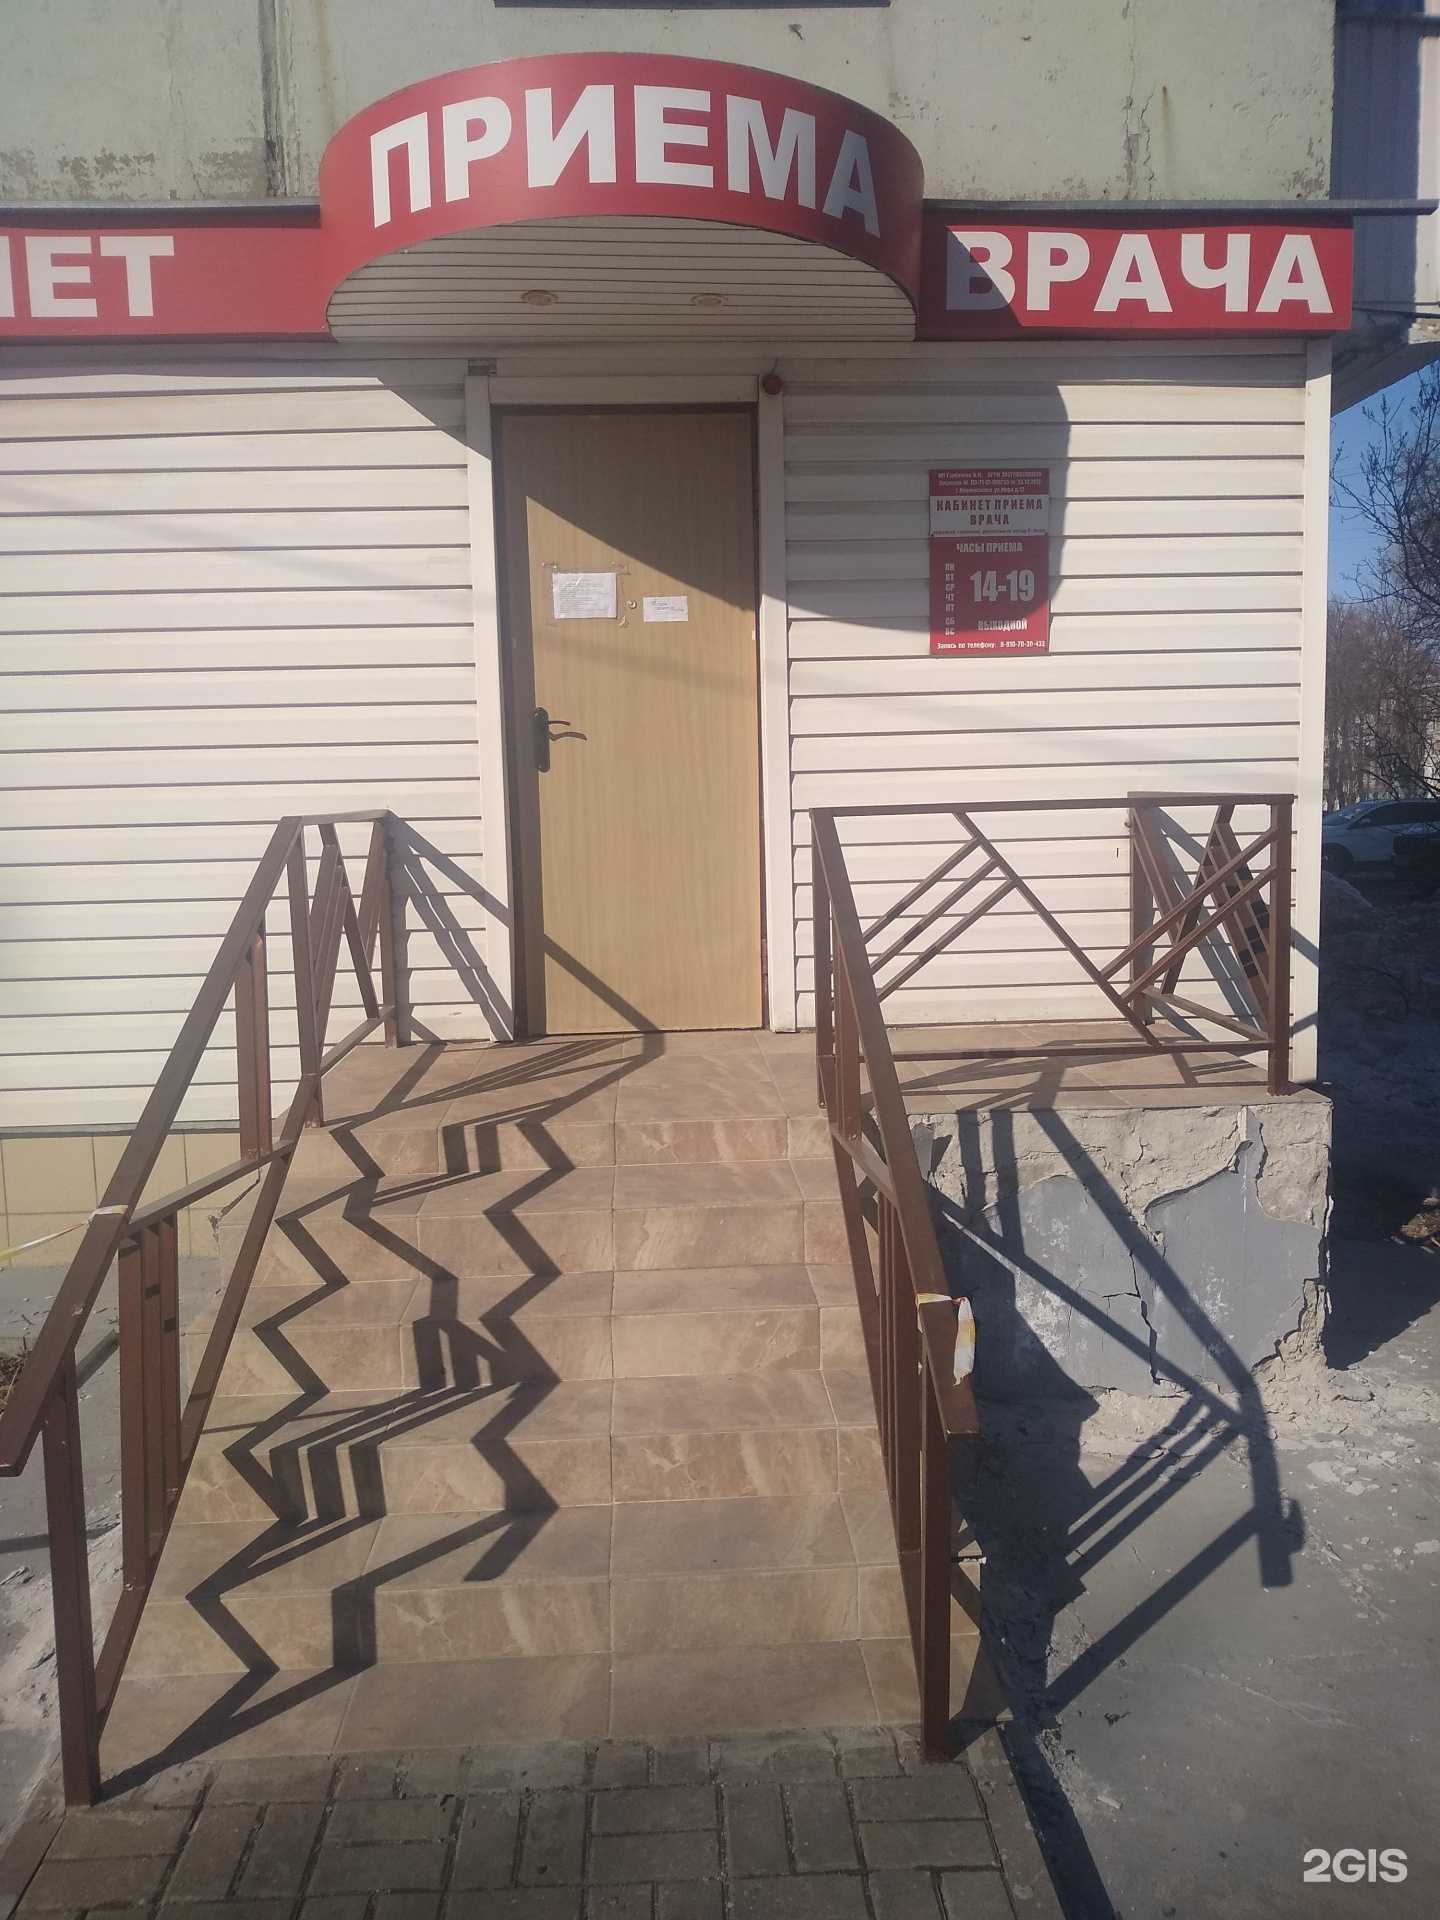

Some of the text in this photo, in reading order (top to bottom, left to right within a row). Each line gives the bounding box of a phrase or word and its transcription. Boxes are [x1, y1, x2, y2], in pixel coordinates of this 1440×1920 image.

[370, 84, 881, 238] ПРИЕМА
[0, 236, 174, 317] ЕТ
[946, 231, 1333, 313] ВРАЧА
[936, 498, 1043, 512] КАБИНЕТ ПРИЕМА
[970, 514, 1010, 526] ВРАЧА
[956, 542, 1024, 553] ЧАСЫ ПРИЕМА
[970, 569, 1035, 602] 14-19
[977, 618, 1027, 632] ВЫХОДНОЙ
